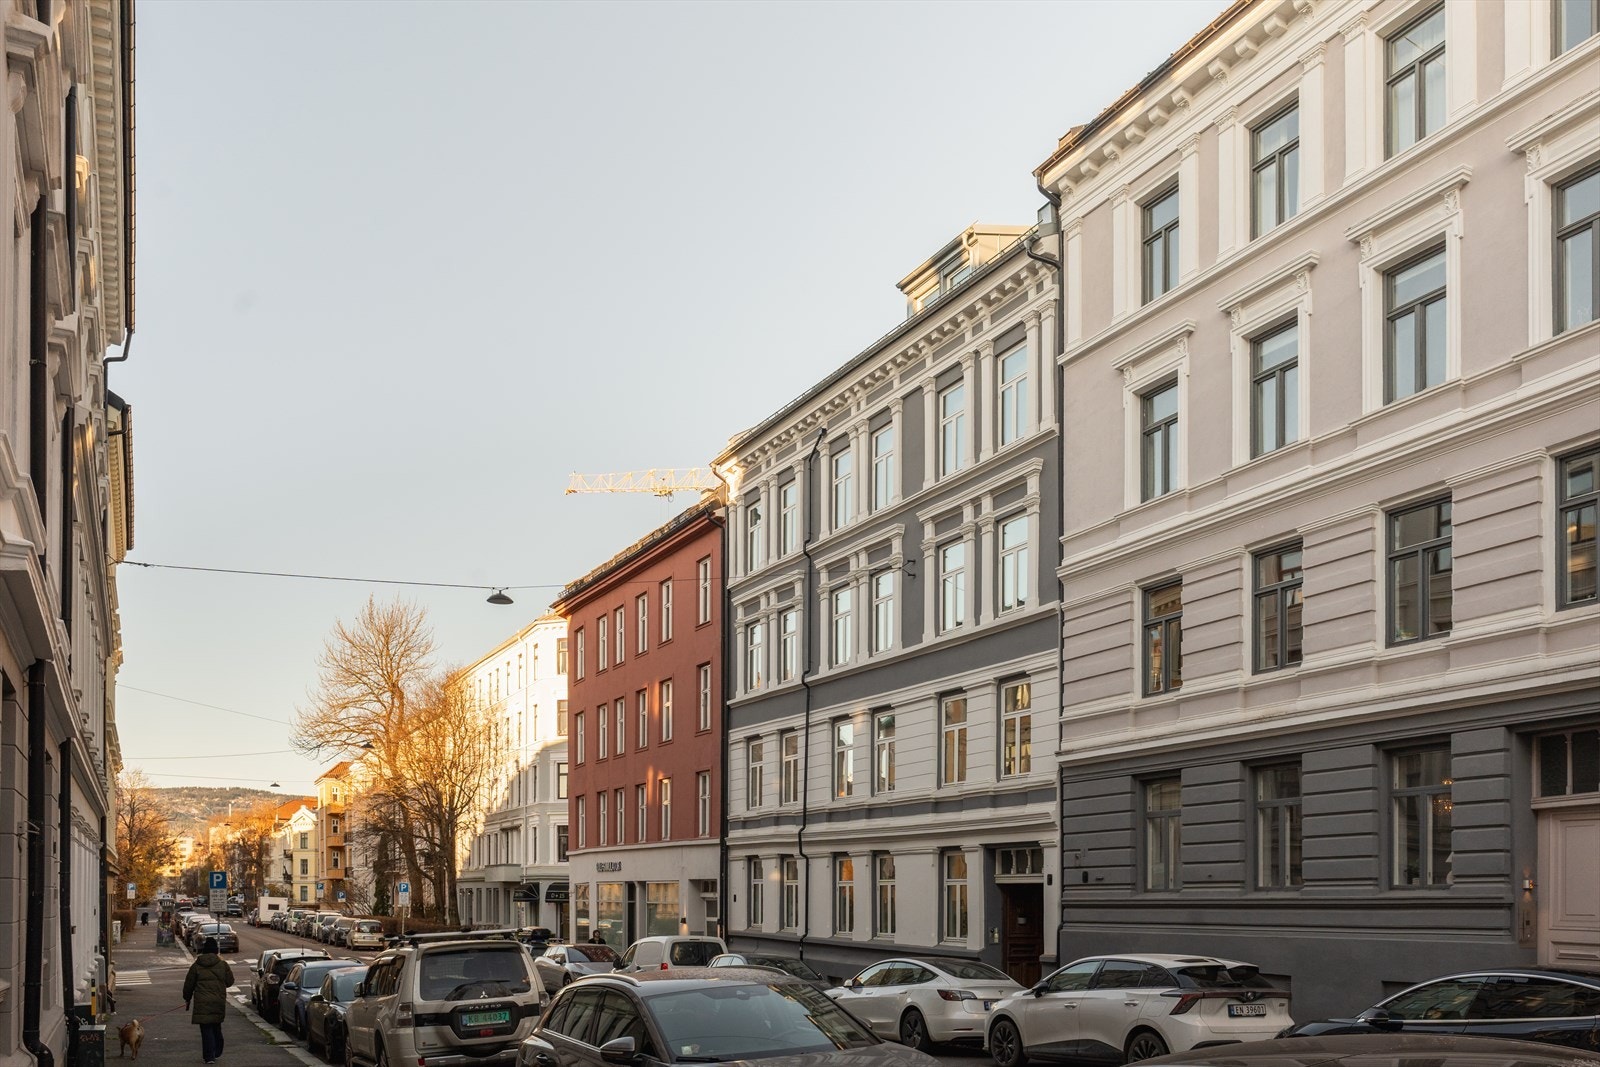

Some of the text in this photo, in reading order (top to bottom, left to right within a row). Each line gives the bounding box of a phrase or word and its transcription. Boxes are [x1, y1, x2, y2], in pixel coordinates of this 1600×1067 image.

[213, 873, 223, 887] P
[1236, 1005, 1265, 1014] EN 39601
[468, 1011, 507, 1024] KB 44037
